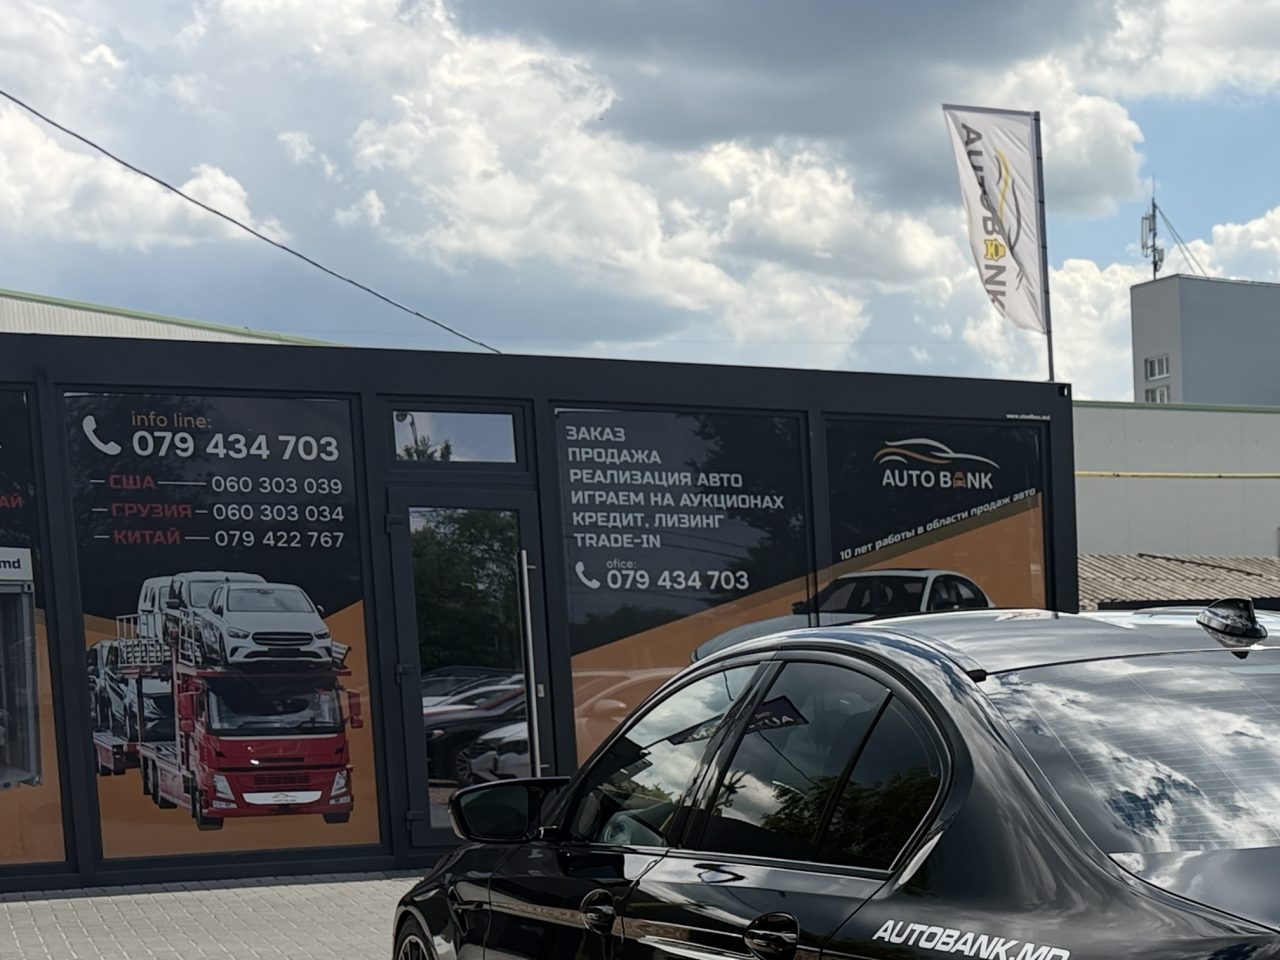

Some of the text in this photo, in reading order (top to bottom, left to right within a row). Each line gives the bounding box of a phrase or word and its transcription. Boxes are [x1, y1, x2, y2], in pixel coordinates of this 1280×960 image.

[131, 411, 212, 429] info line:
[565, 425, 626, 442] ЗАКАЗ
[132, 430, 339, 462] 079 434 703
[568, 447, 662, 465] ПРОДАЖА
[109, 474, 343, 495] США 060 303 039
[569, 469, 743, 488] РЕАЛИЗАЦИЯ АВТО
[882, 469, 935, 488] AUTO
[571, 490, 785, 510] ИГРАЕМ НА АУКЦИОНАХ
[111, 503, 344, 522] ГРУЗИЯ 060 303 034
[654, 513, 725, 528] ЛИЗИНГ
[839, 549, 852, 561] 10
[854, 543, 874, 556] лет
[875, 529, 915, 551] работы
[926, 511, 969, 532] области
[970, 496, 1011, 516] продаж
[1013, 487, 1036, 502] авто
[114, 527, 344, 548] КИТАЙ 079 422 767
[573, 533, 662, 548] TRADE-IN
[606, 570, 750, 590] 079 434 703
